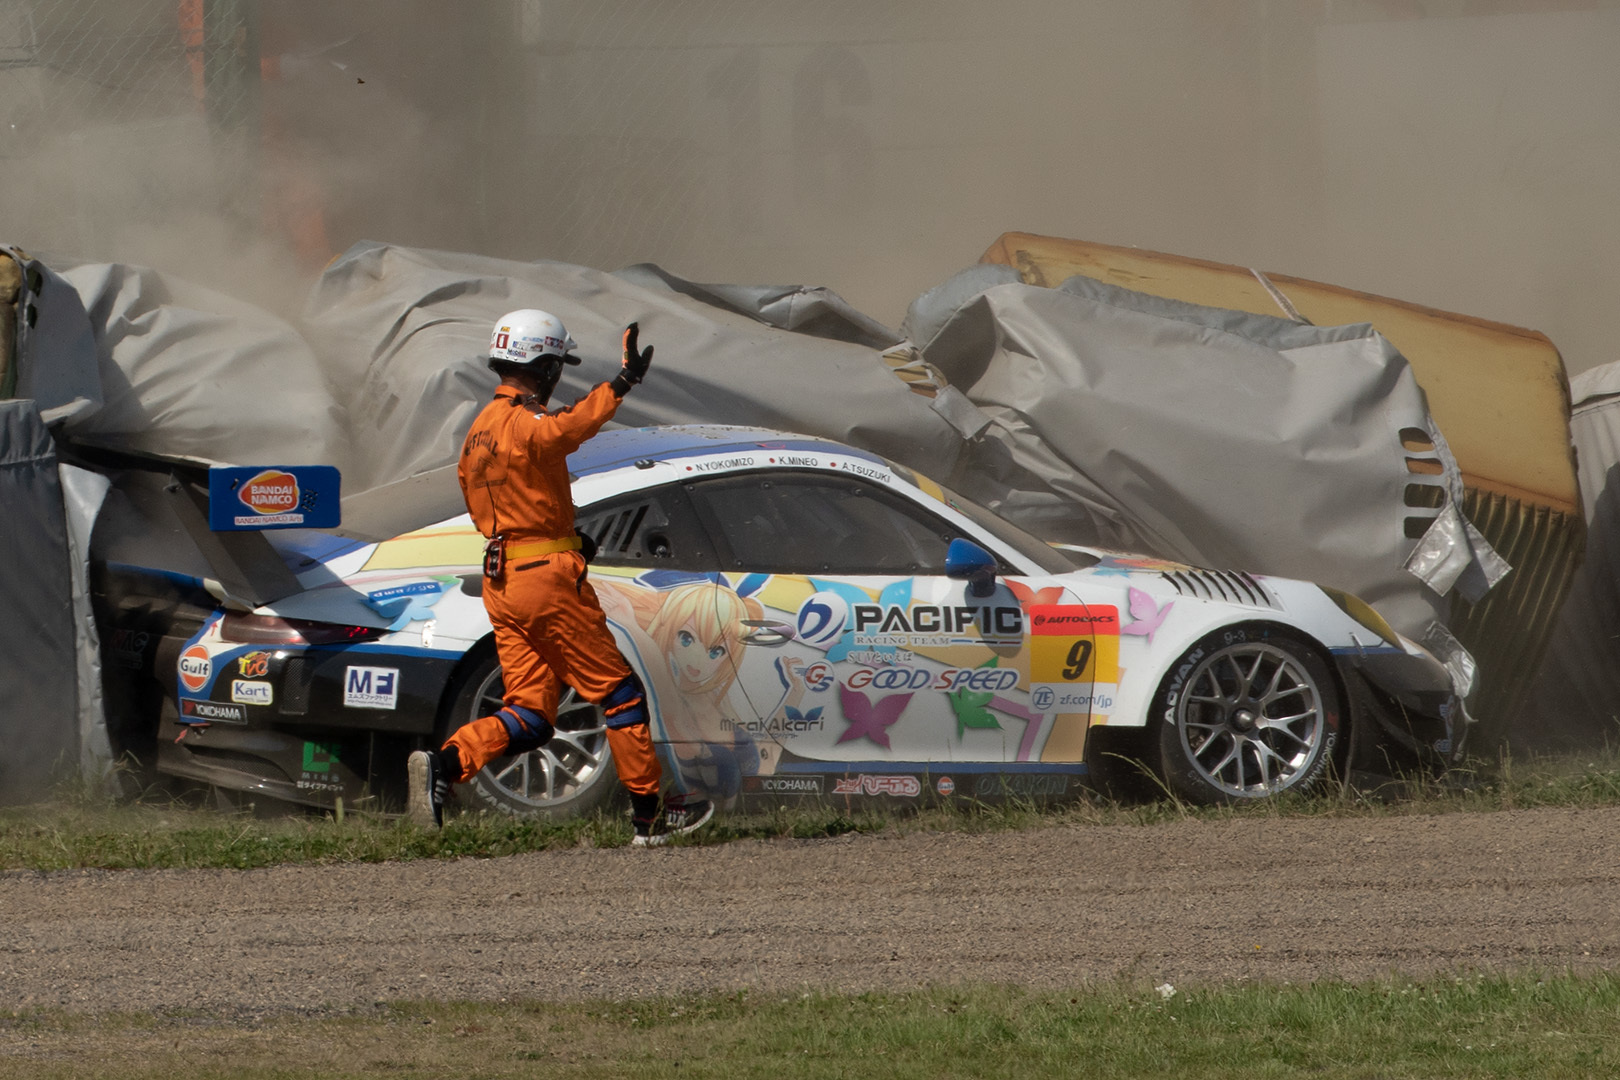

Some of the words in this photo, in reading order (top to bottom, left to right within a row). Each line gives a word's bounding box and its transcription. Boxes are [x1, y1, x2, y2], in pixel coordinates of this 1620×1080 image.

[695, 456, 755, 472] N.YOKOMIZO
[779, 455, 818, 467] K.MINEO
[842, 461, 891, 483] A.TSUZUKI
[251, 485, 293, 495] BANDAI
[251, 495, 293, 505] NAMCO
[235, 517, 261, 525] BANDAI
[262, 515, 288, 524] NAMCO
[854, 605, 1023, 633] PACIFIC
[1047, 615, 1115, 624] AUTOBACS
[856, 636, 907, 645] RACING
[911, 636, 949, 645] TEAM
[180, 658, 209, 676] Gulf
[1062, 640, 1093, 680] 9
[848, 669, 931, 689] GOOD
[934, 669, 1018, 690] SPEED
[1164, 647, 1206, 727] ADVAN
[235, 682, 269, 697] Kart
[1036, 690, 1052, 705] ZF
[1059, 694, 1113, 709] zf.com/jp
[195, 704, 242, 721] YOKOHAMA
[767, 716, 825, 732] Akari
[1300, 731, 1338, 790] YOKOHAMA
[760, 779, 819, 791] YOKOHAMA
